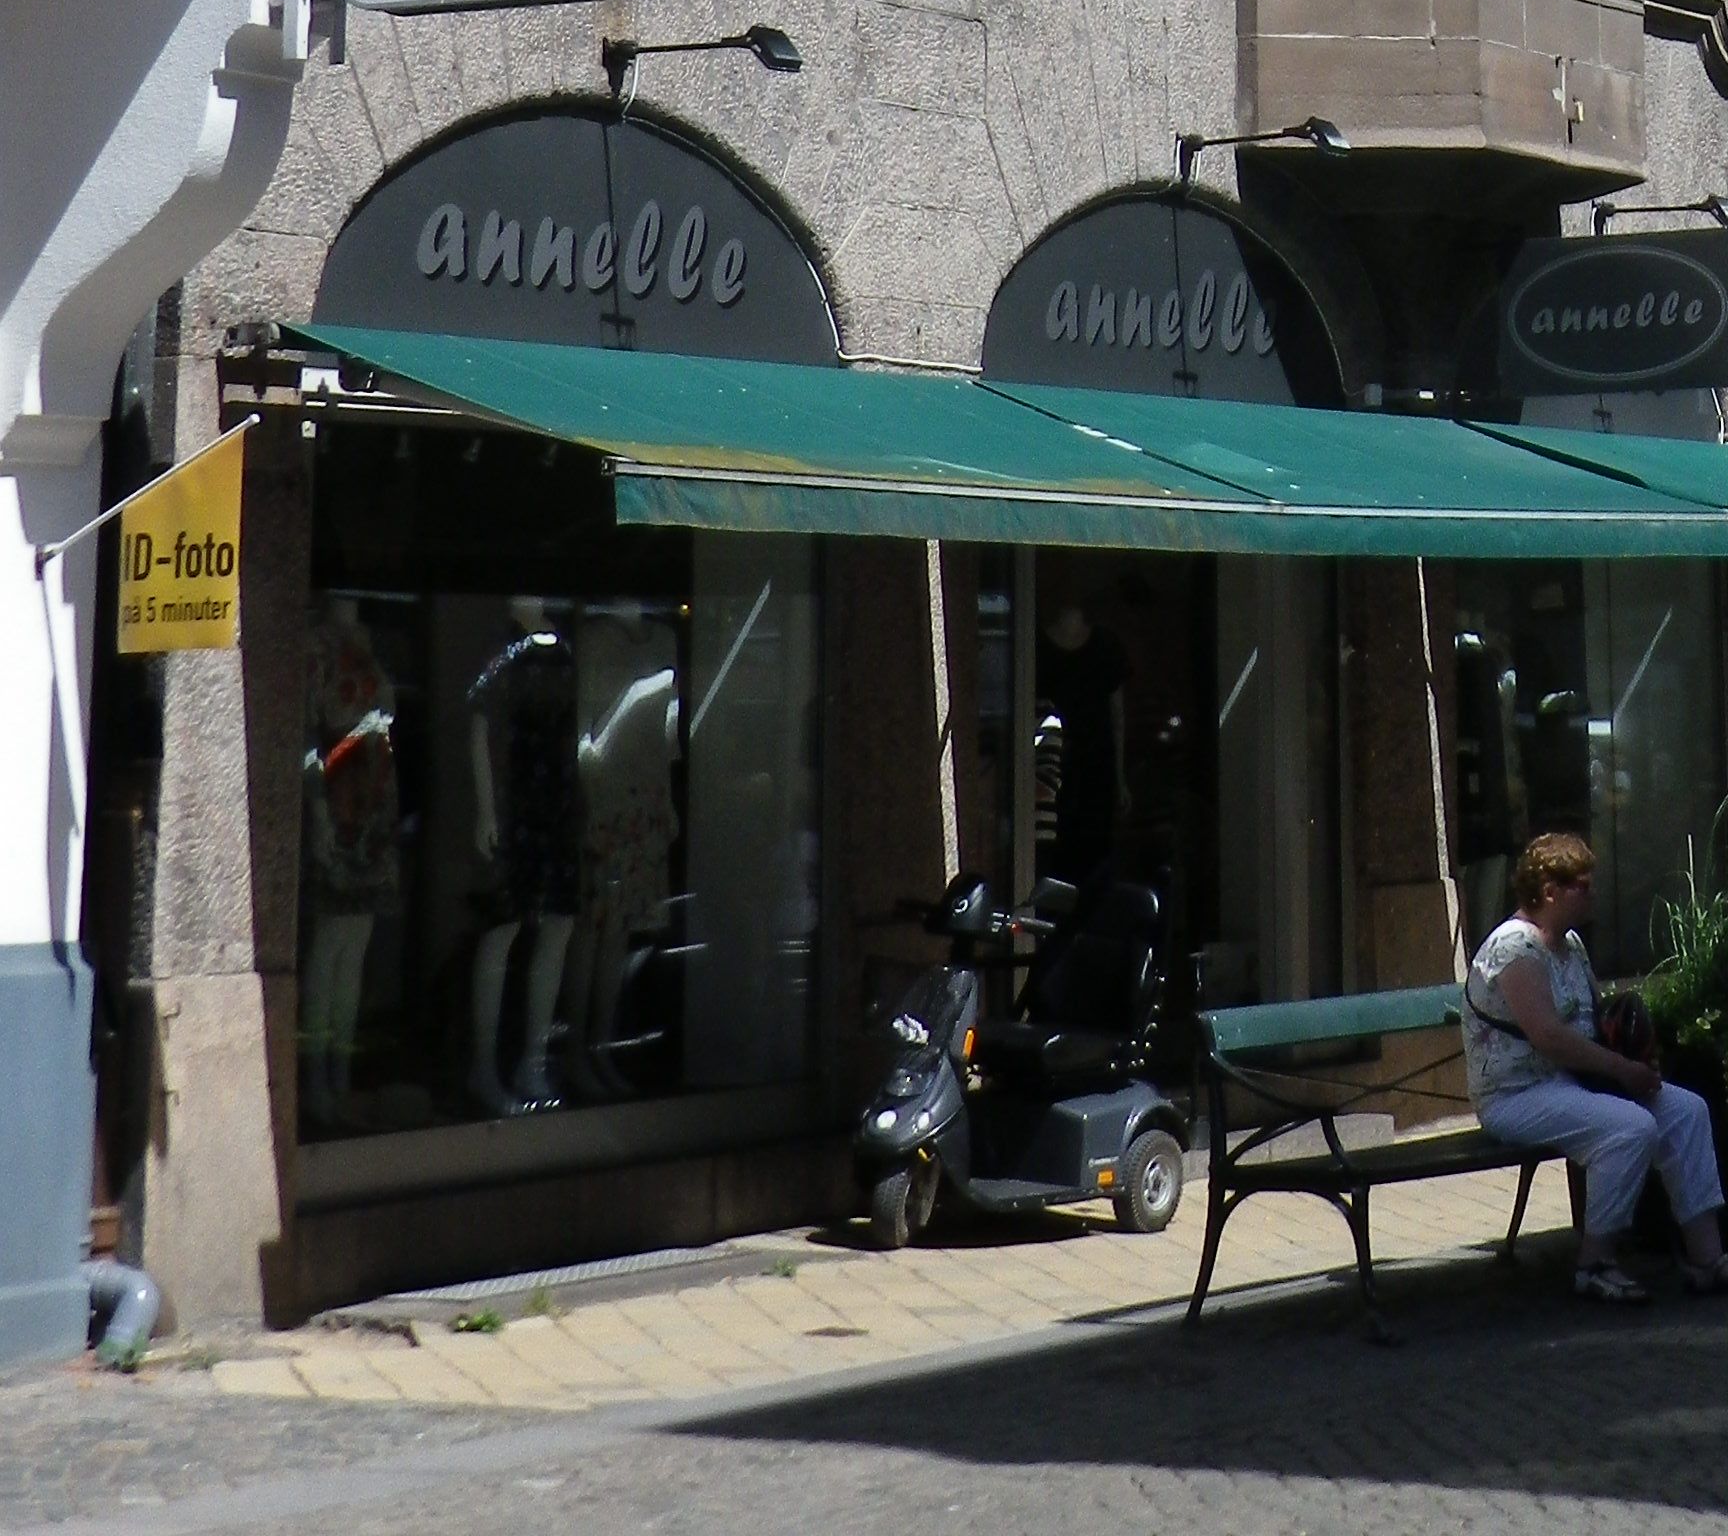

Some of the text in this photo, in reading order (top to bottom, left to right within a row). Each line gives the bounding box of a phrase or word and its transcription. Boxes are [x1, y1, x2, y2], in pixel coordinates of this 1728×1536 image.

[416, 198, 746, 305] annelle
[1531, 290, 1704, 334] annelle
[124, 530, 234, 581] ID-foto
[146, 596, 157, 624] 5
[161, 595, 232, 623] minuter
